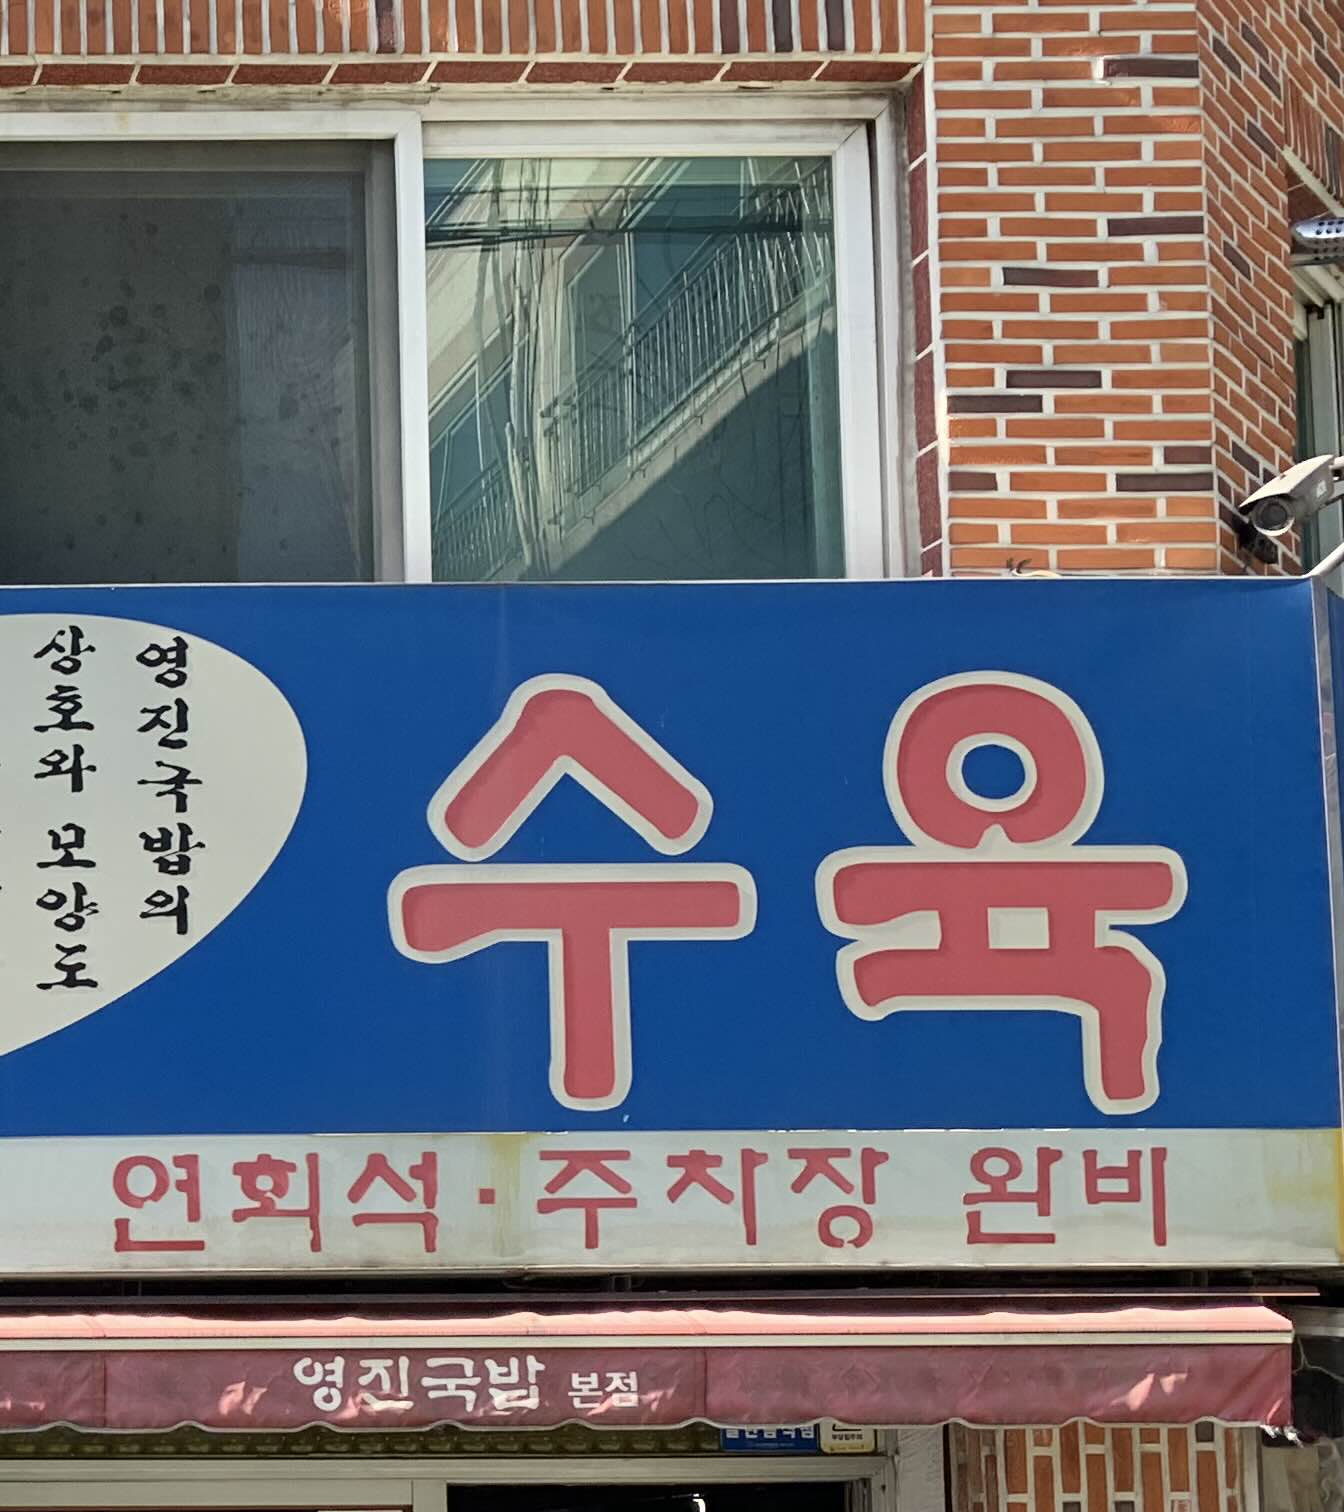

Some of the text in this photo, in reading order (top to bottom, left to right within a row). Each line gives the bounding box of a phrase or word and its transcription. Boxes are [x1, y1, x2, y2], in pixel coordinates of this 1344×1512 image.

[135, 635, 205, 936] 영진국밥의
[387, 669, 1188, 1115] 수육
[961, 1146, 1168, 1247] 완비
[293, 1354, 639, 1412] 영진국밥 본점
